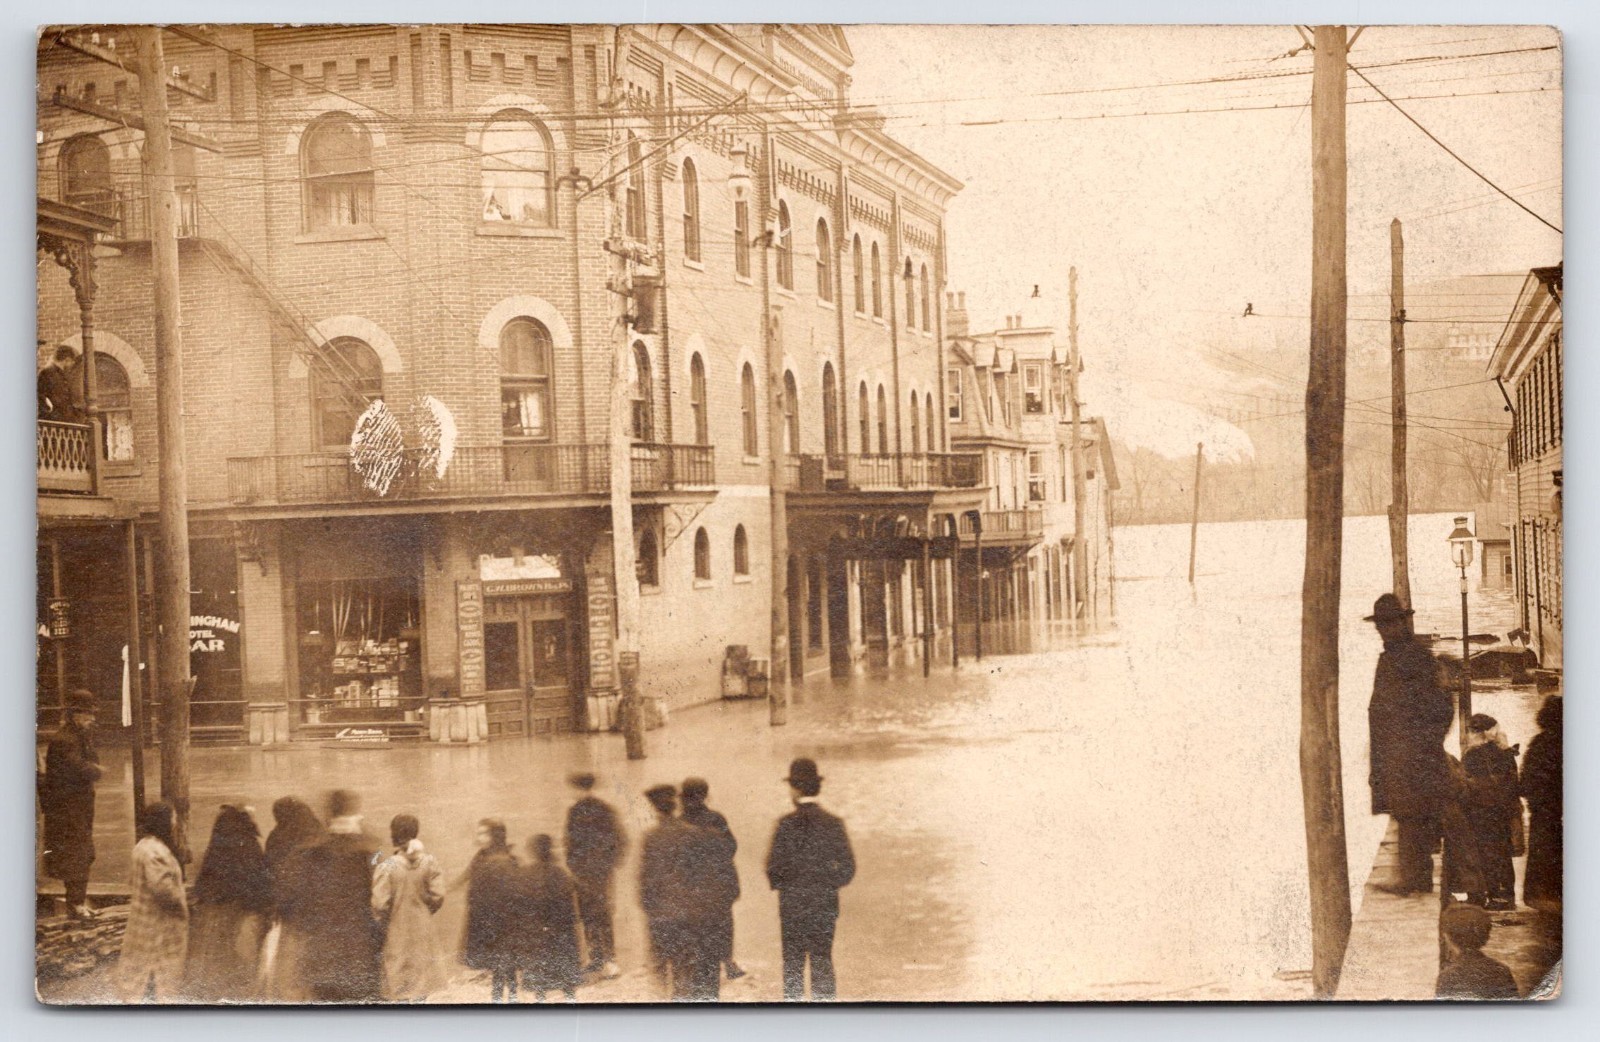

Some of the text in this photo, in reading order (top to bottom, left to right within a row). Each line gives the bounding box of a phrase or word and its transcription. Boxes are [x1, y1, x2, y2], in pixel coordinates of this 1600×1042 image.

[190, 615, 240, 634] INGHAM
[189, 629, 216, 639] OTEL
[189, 639, 225, 652] AR
